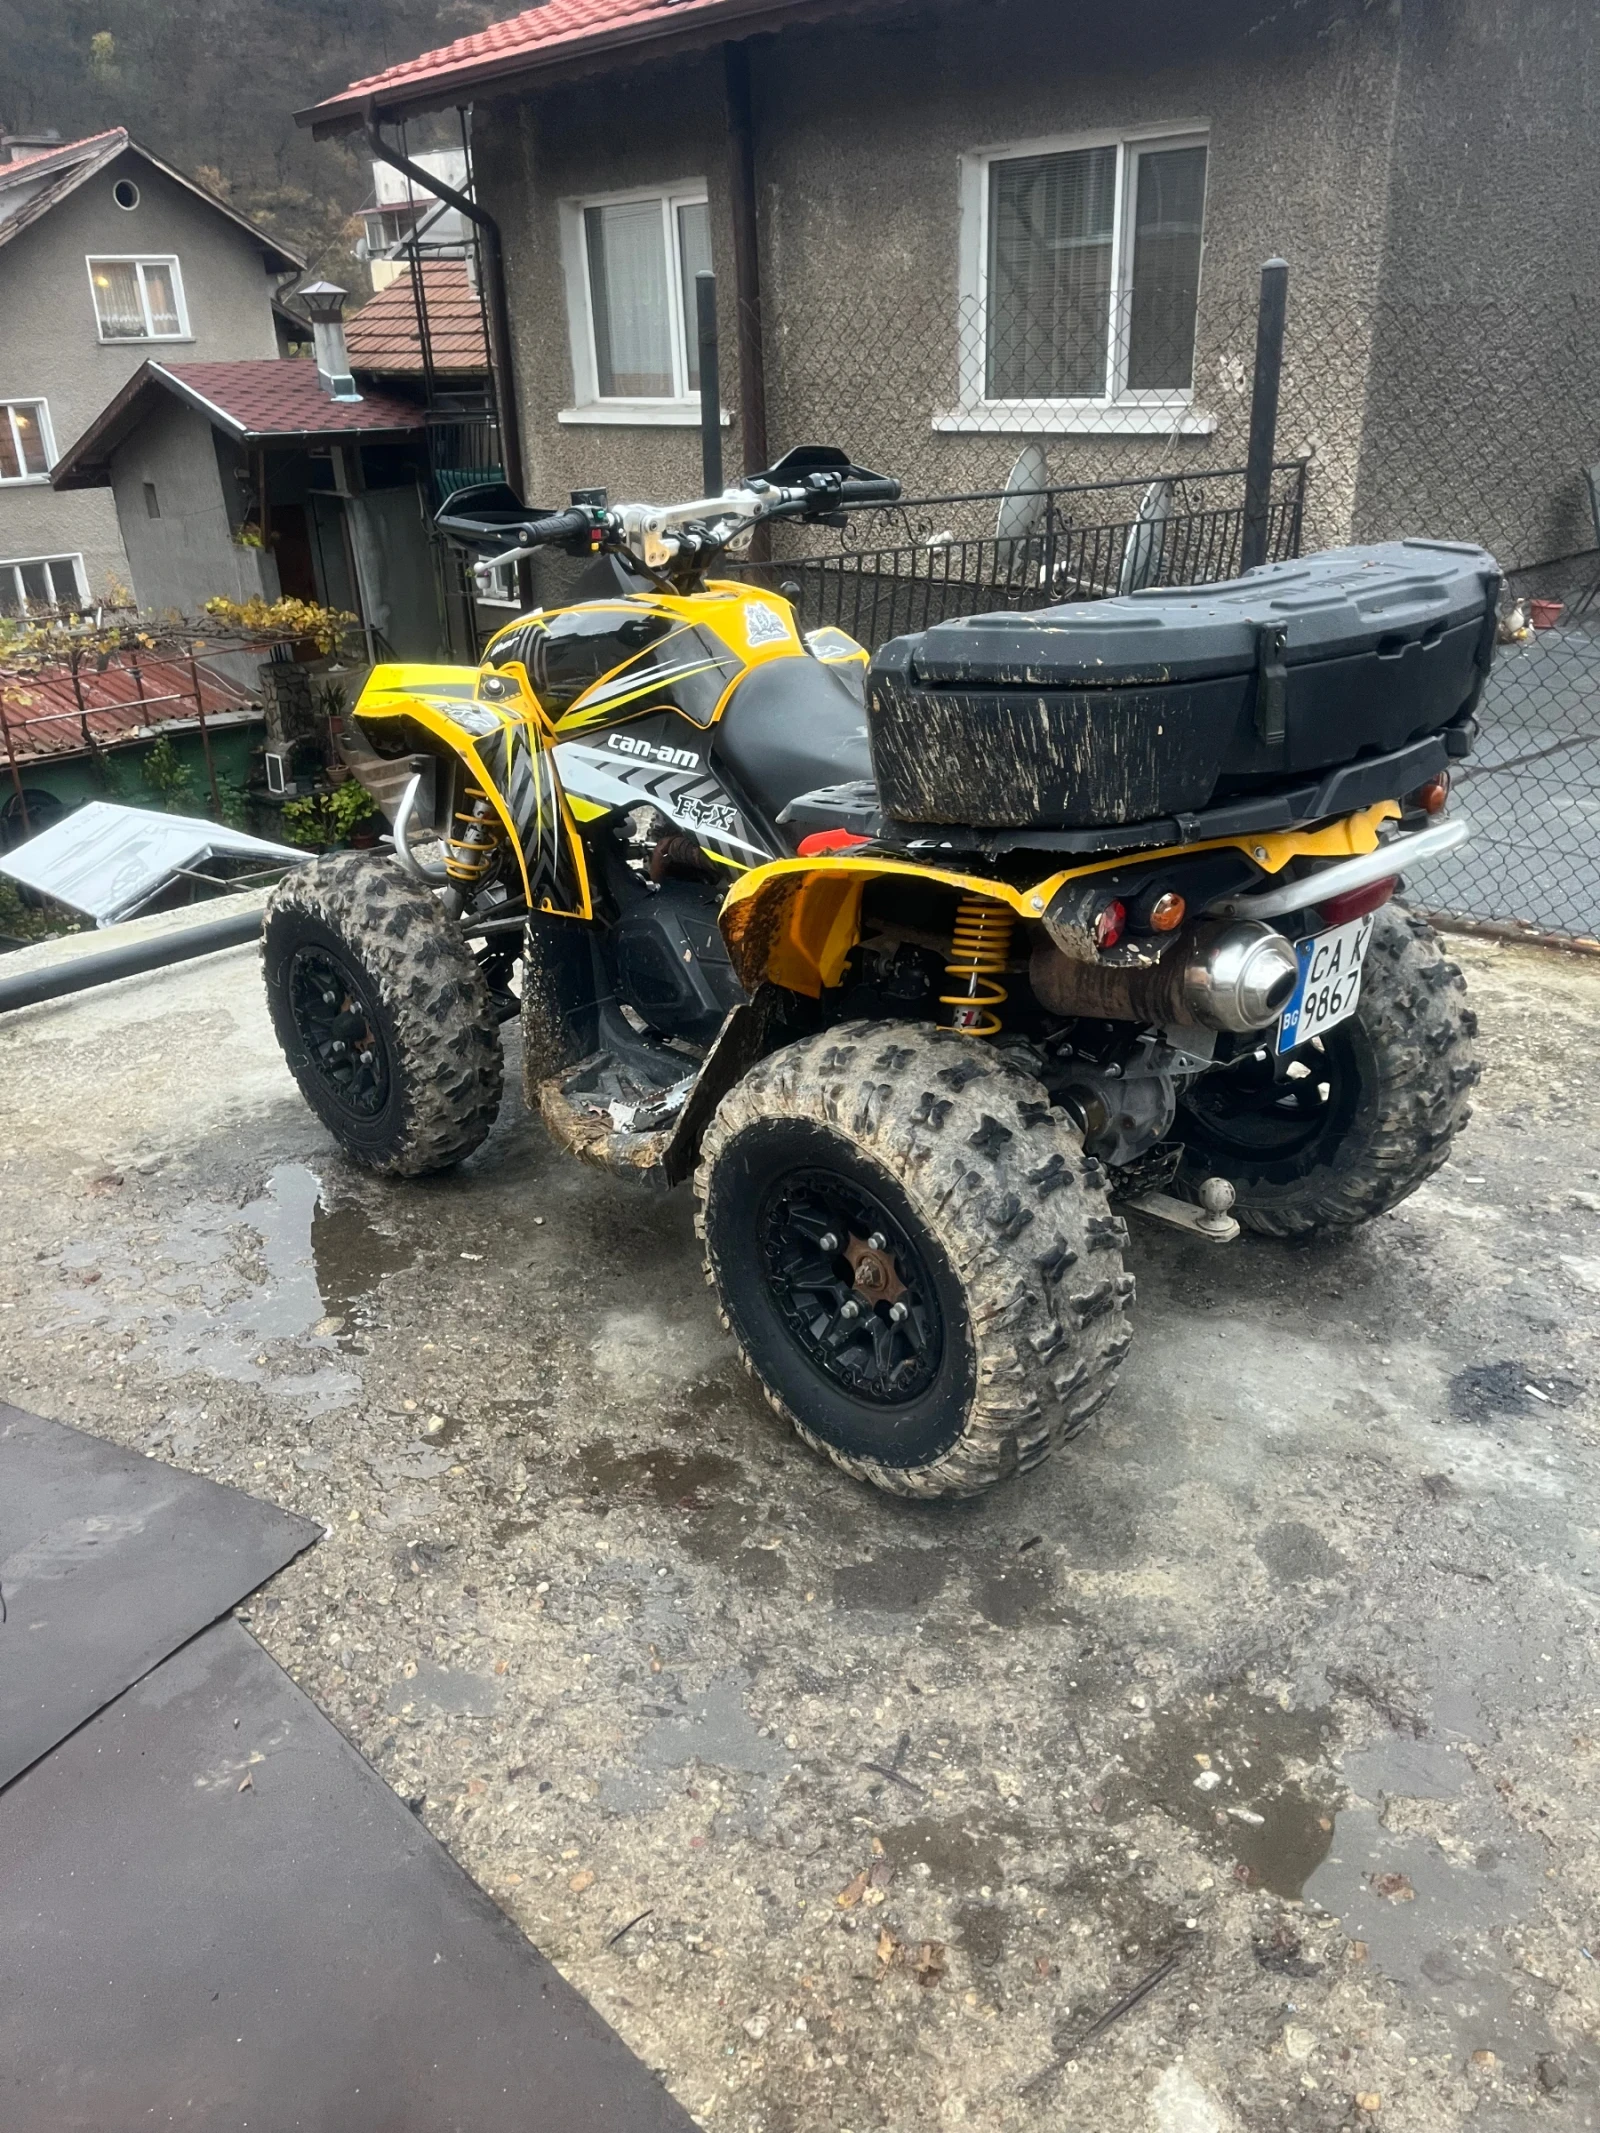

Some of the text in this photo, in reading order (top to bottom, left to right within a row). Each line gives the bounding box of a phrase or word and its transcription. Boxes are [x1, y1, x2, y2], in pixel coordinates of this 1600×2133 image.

[607, 733, 699, 768] can-am
[1303, 969, 1359, 1032] 9867
[1283, 1010, 1299, 1029] BG
